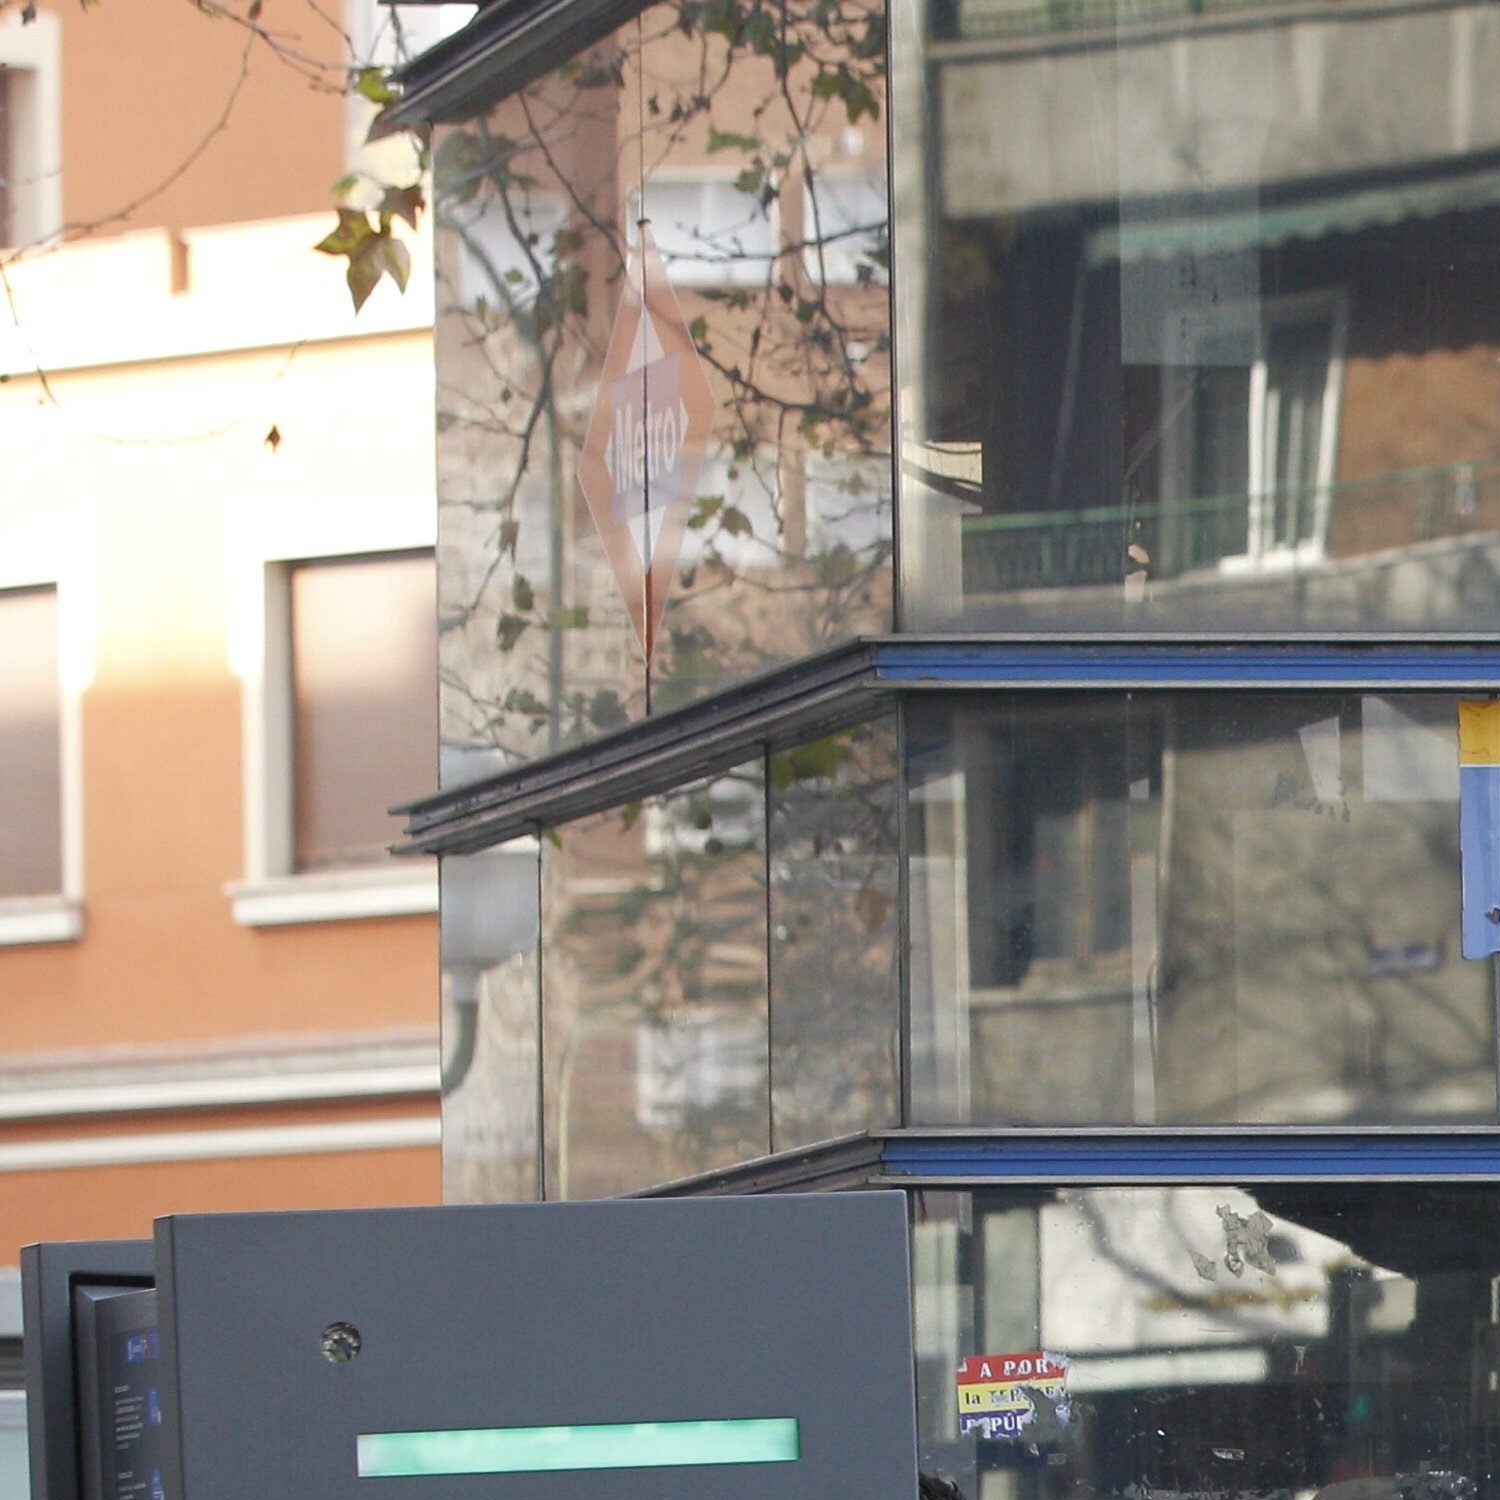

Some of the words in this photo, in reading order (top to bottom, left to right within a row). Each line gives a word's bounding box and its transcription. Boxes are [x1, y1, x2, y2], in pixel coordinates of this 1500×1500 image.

[980, 1362, 992, 1378] A
[1003, 1358, 1049, 1376] POR
[965, 1392, 981, 1405] la
